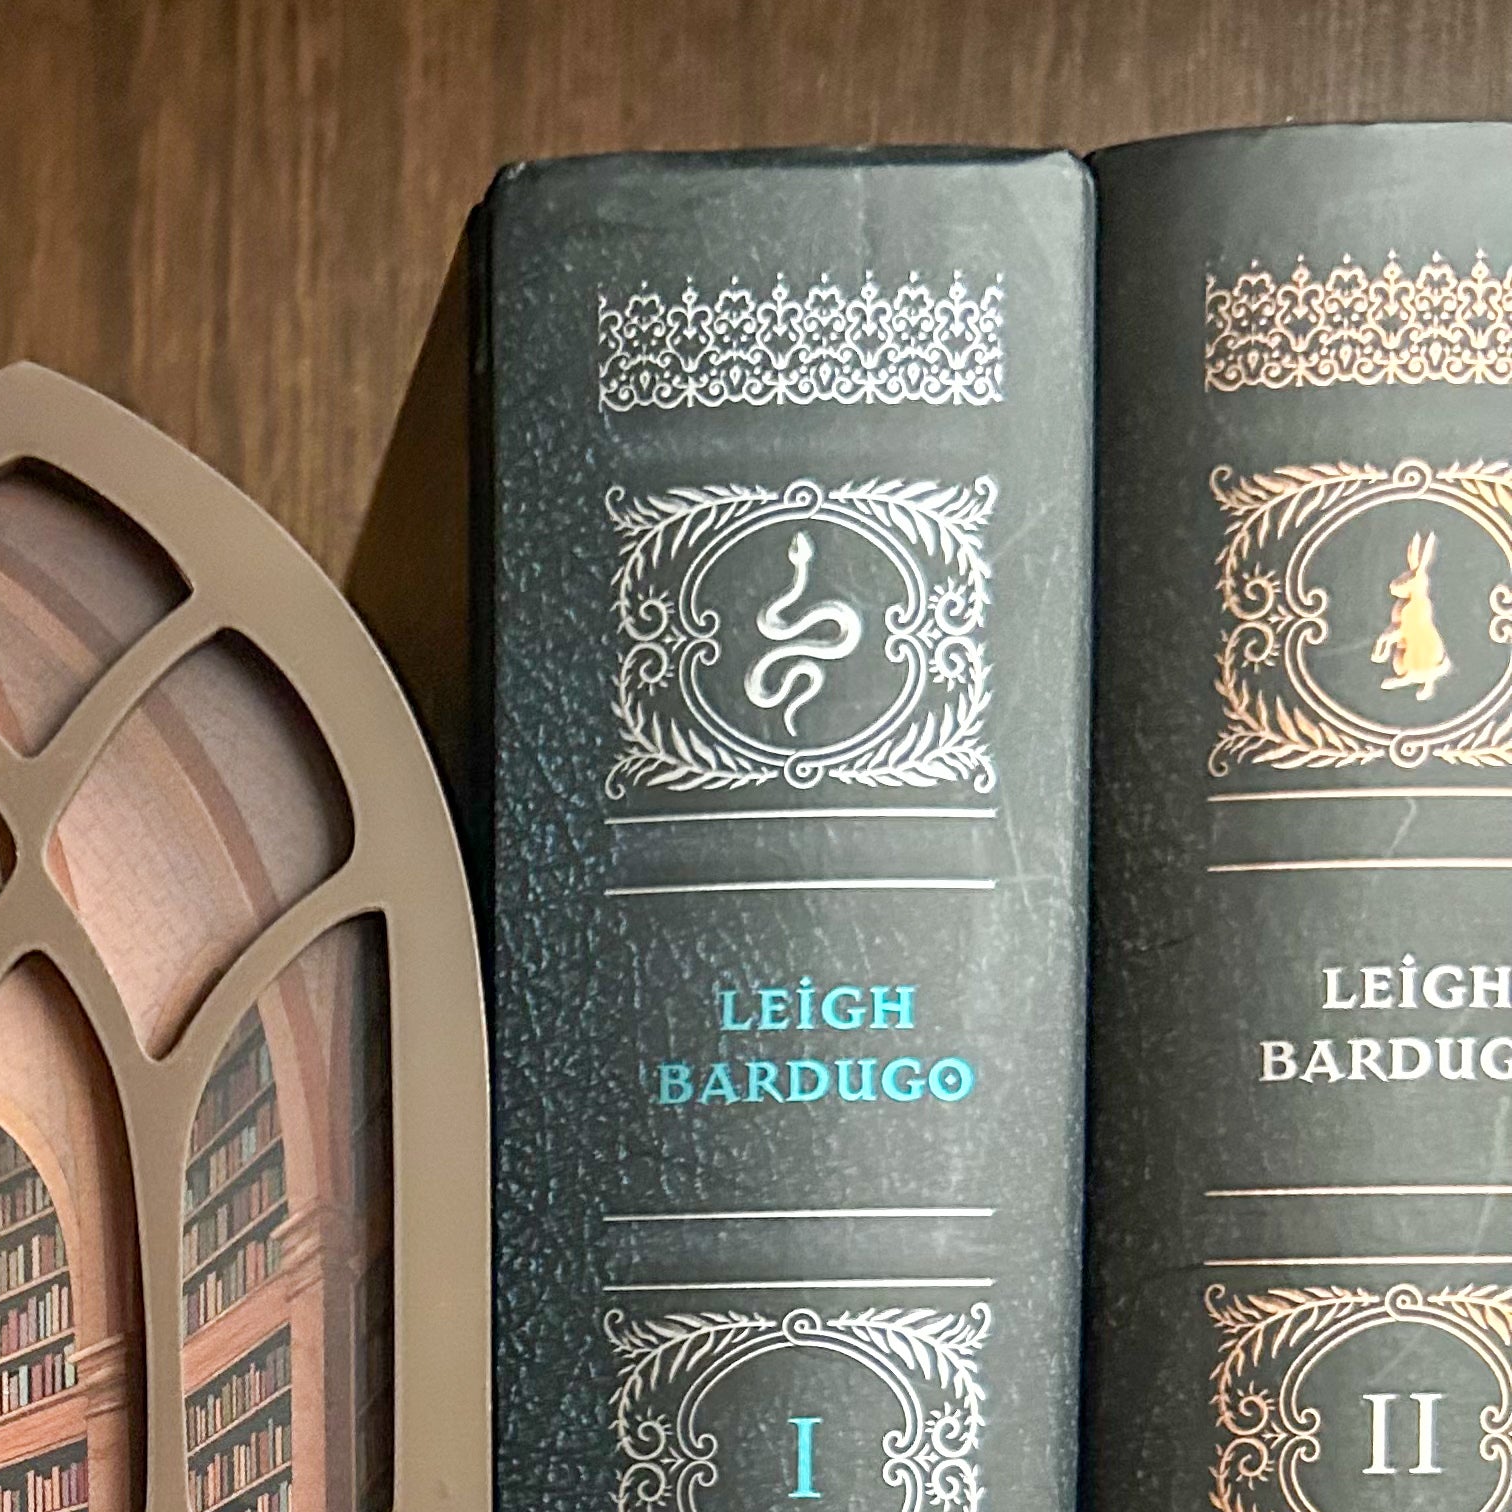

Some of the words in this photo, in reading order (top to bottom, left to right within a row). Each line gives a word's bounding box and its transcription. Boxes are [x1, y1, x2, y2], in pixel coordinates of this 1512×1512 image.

[718, 976, 916, 1031] LEIGH
[1321, 953, 1512, 1010] LEIGH
[658, 1056, 975, 1105] BARDUGO
[787, 1416, 821, 1499] I
[1361, 1391, 1444, 1476] II
